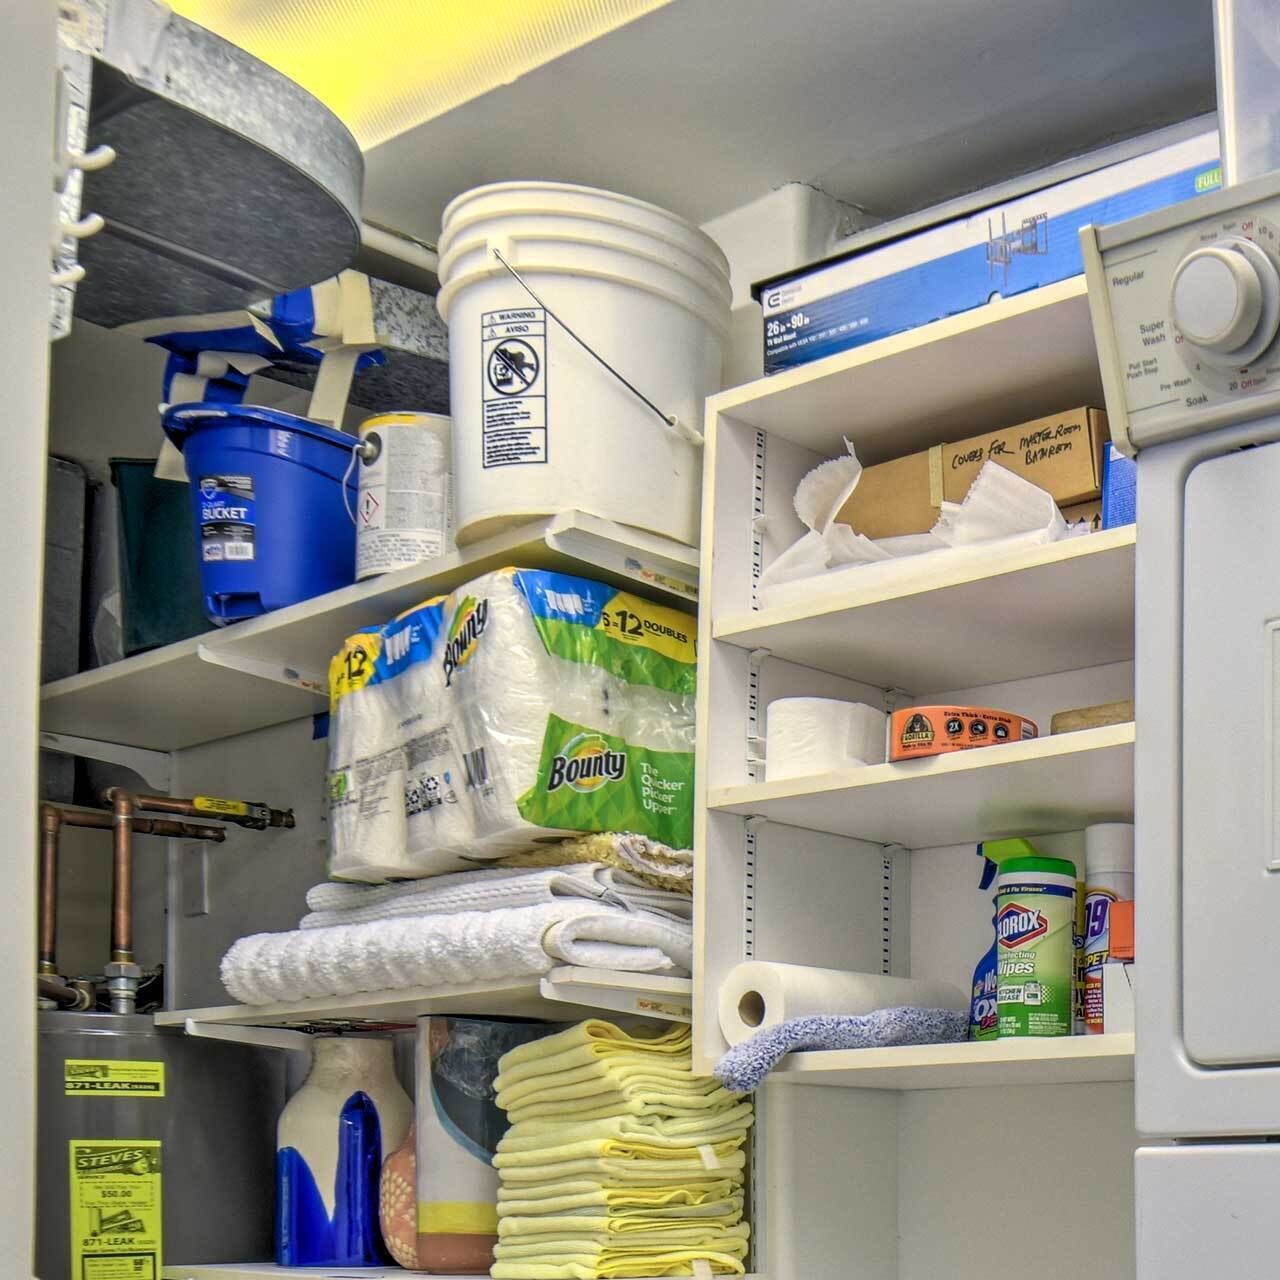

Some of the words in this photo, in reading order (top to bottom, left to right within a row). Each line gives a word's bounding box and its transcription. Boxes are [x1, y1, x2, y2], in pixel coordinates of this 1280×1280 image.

[1242, 220, 1254, 232] Off
[1112, 270, 1144, 287] Regular
[499, 311, 536, 321] WARNING
[505, 325, 529, 334] AVISO
[1140, 320, 1164, 335] Super
[1143, 334, 1165, 347] Wash
[1186, 393, 1208, 407] Soak
[202, 507, 248, 520] BUCKET
[615, 610, 643, 637] 12
[643, 619, 687, 643] DOUBLES
[443, 599, 488, 687] Bounty
[345, 646, 367, 680] 12
[949, 721, 959, 731] 2X
[548, 750, 625, 791] Bounty
[640, 763, 659, 775] The
[998, 910, 1041, 939] LOROX
[1085, 952, 1109, 967] PET
[65, 1082, 130, 1090] 871-LEAK
[78, 1150, 143, 1168] STEVES
[101, 1190, 132, 1199] $50.00
[82, 1237, 135, 1247] 871-LEAK
